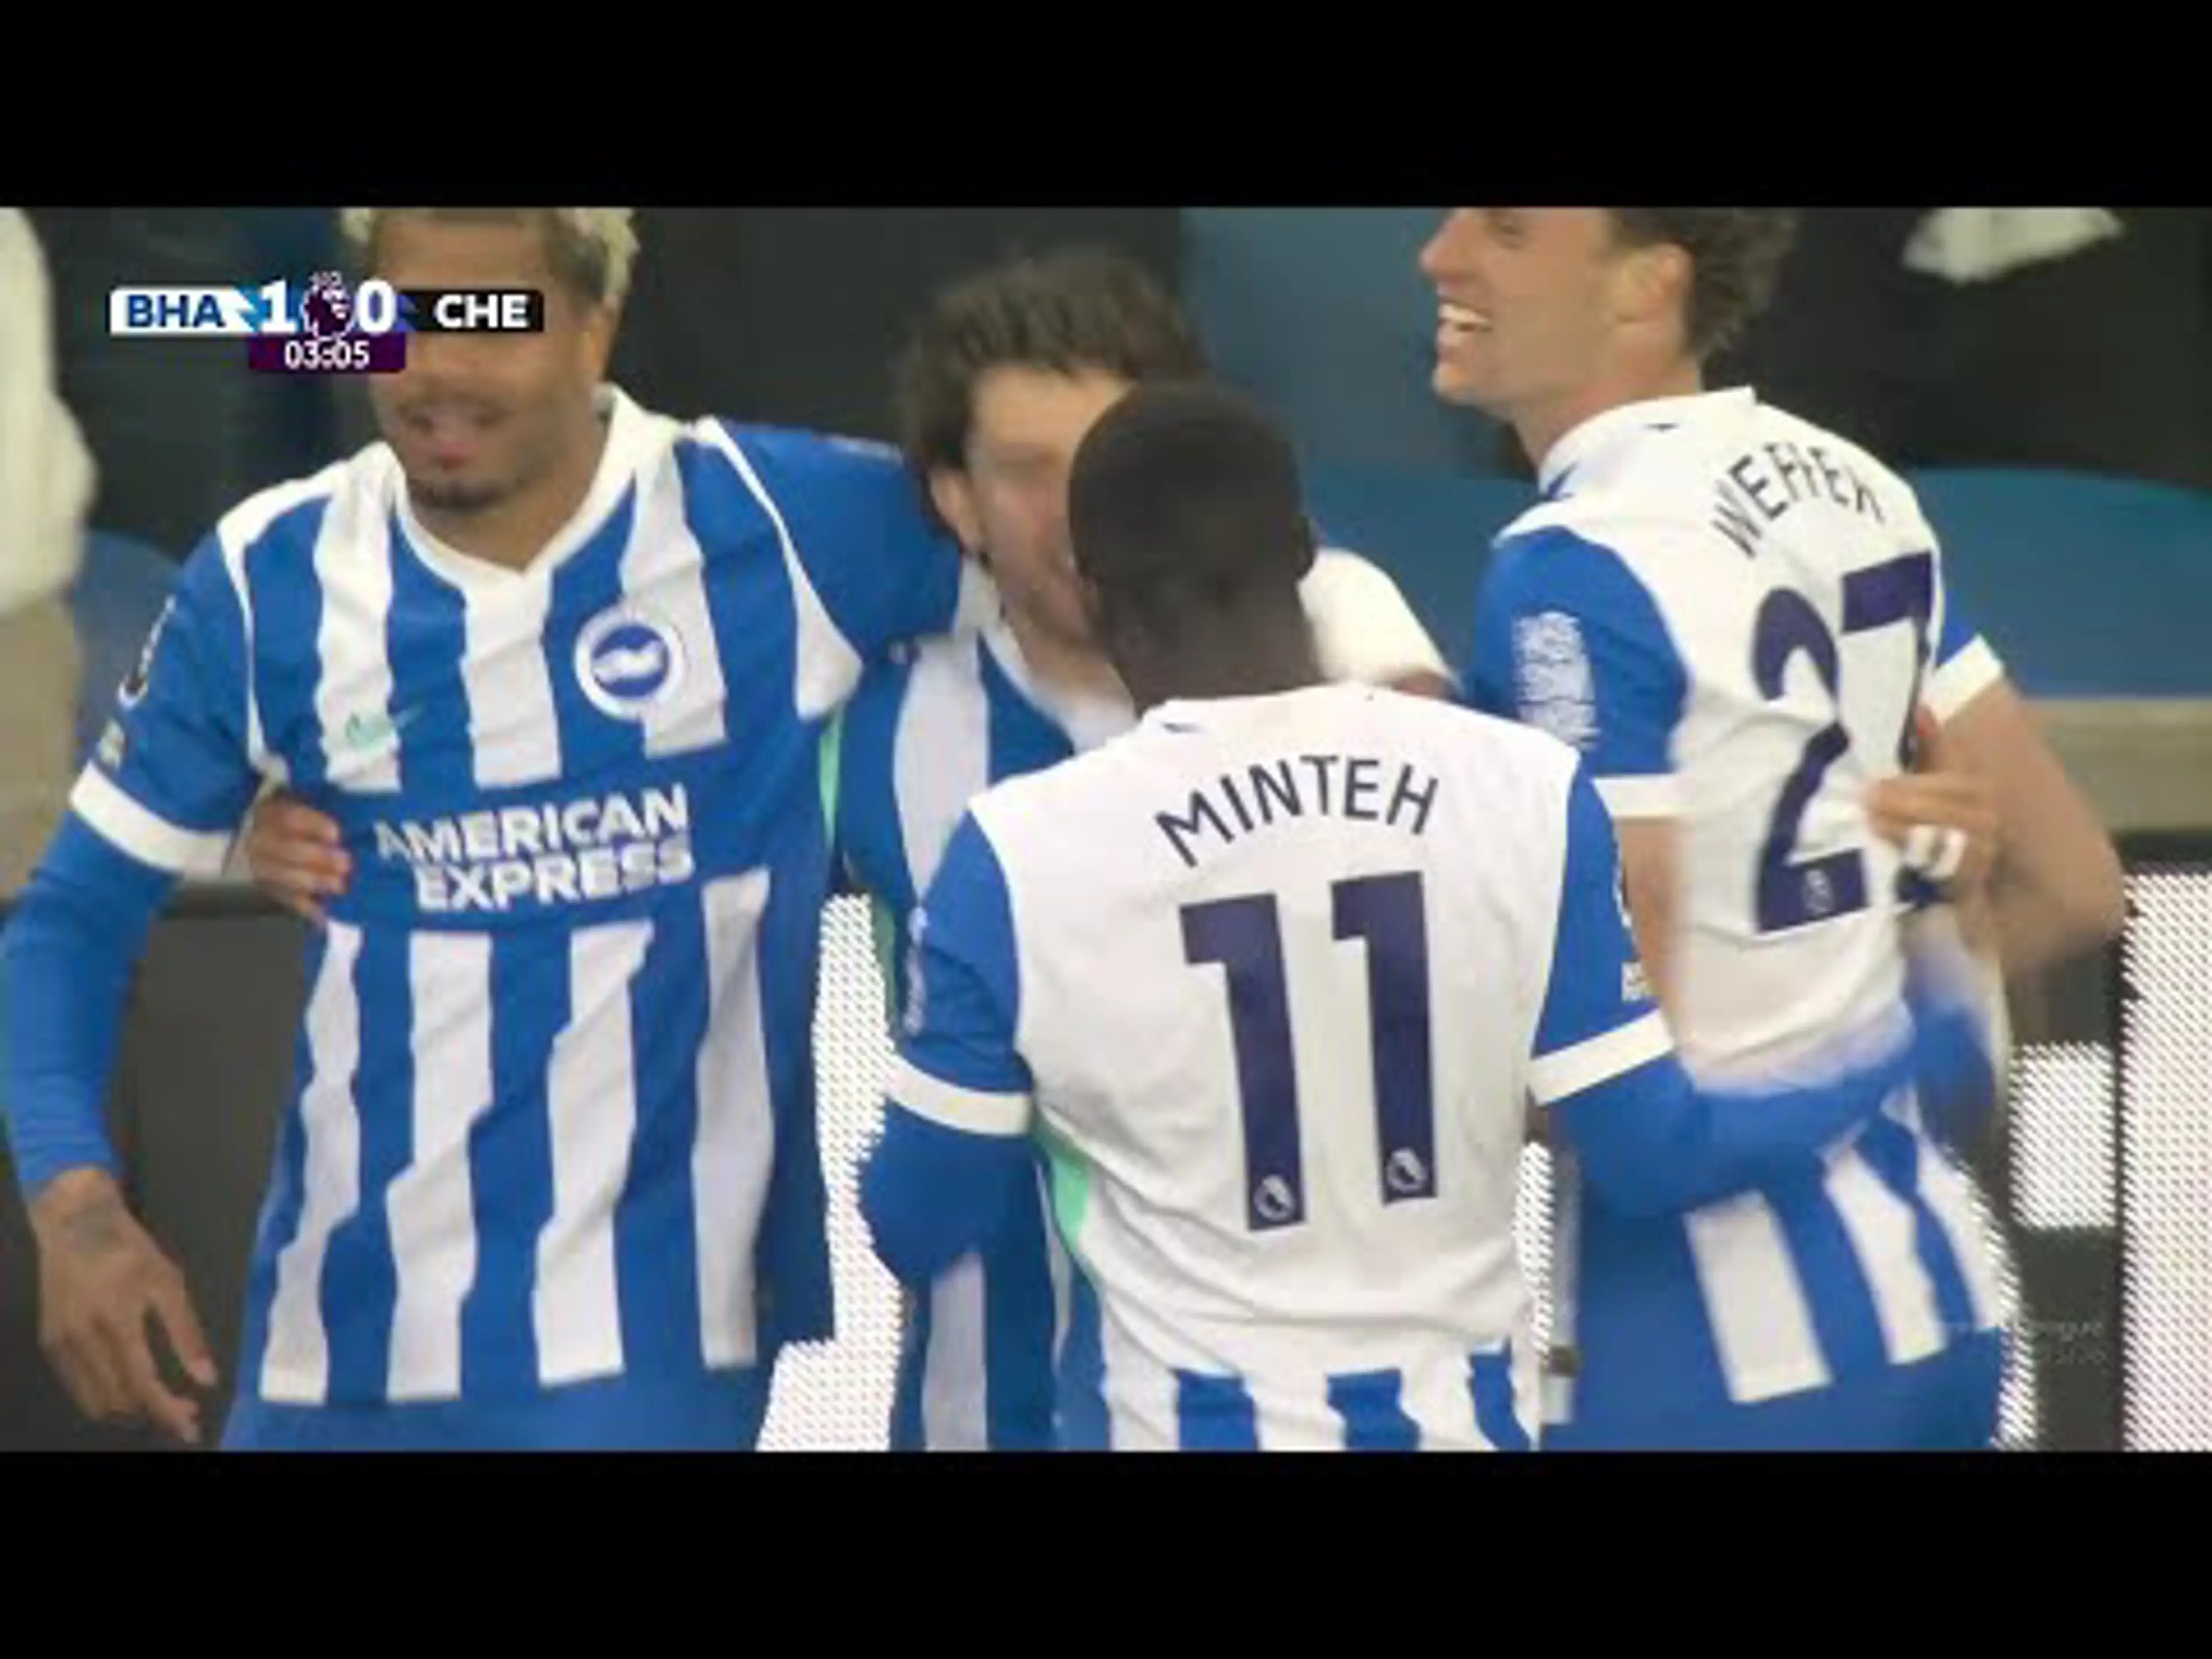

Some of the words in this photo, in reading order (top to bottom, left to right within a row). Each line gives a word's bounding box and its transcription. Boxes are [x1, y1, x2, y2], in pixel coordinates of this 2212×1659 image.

[1752, 551, 1936, 934] 27
[374, 782, 688, 860] AMERICAN
[1155, 755, 1438, 868] MINTEH
[414, 832, 695, 912] EXPRESS
[1179, 870, 1438, 1232] 11
